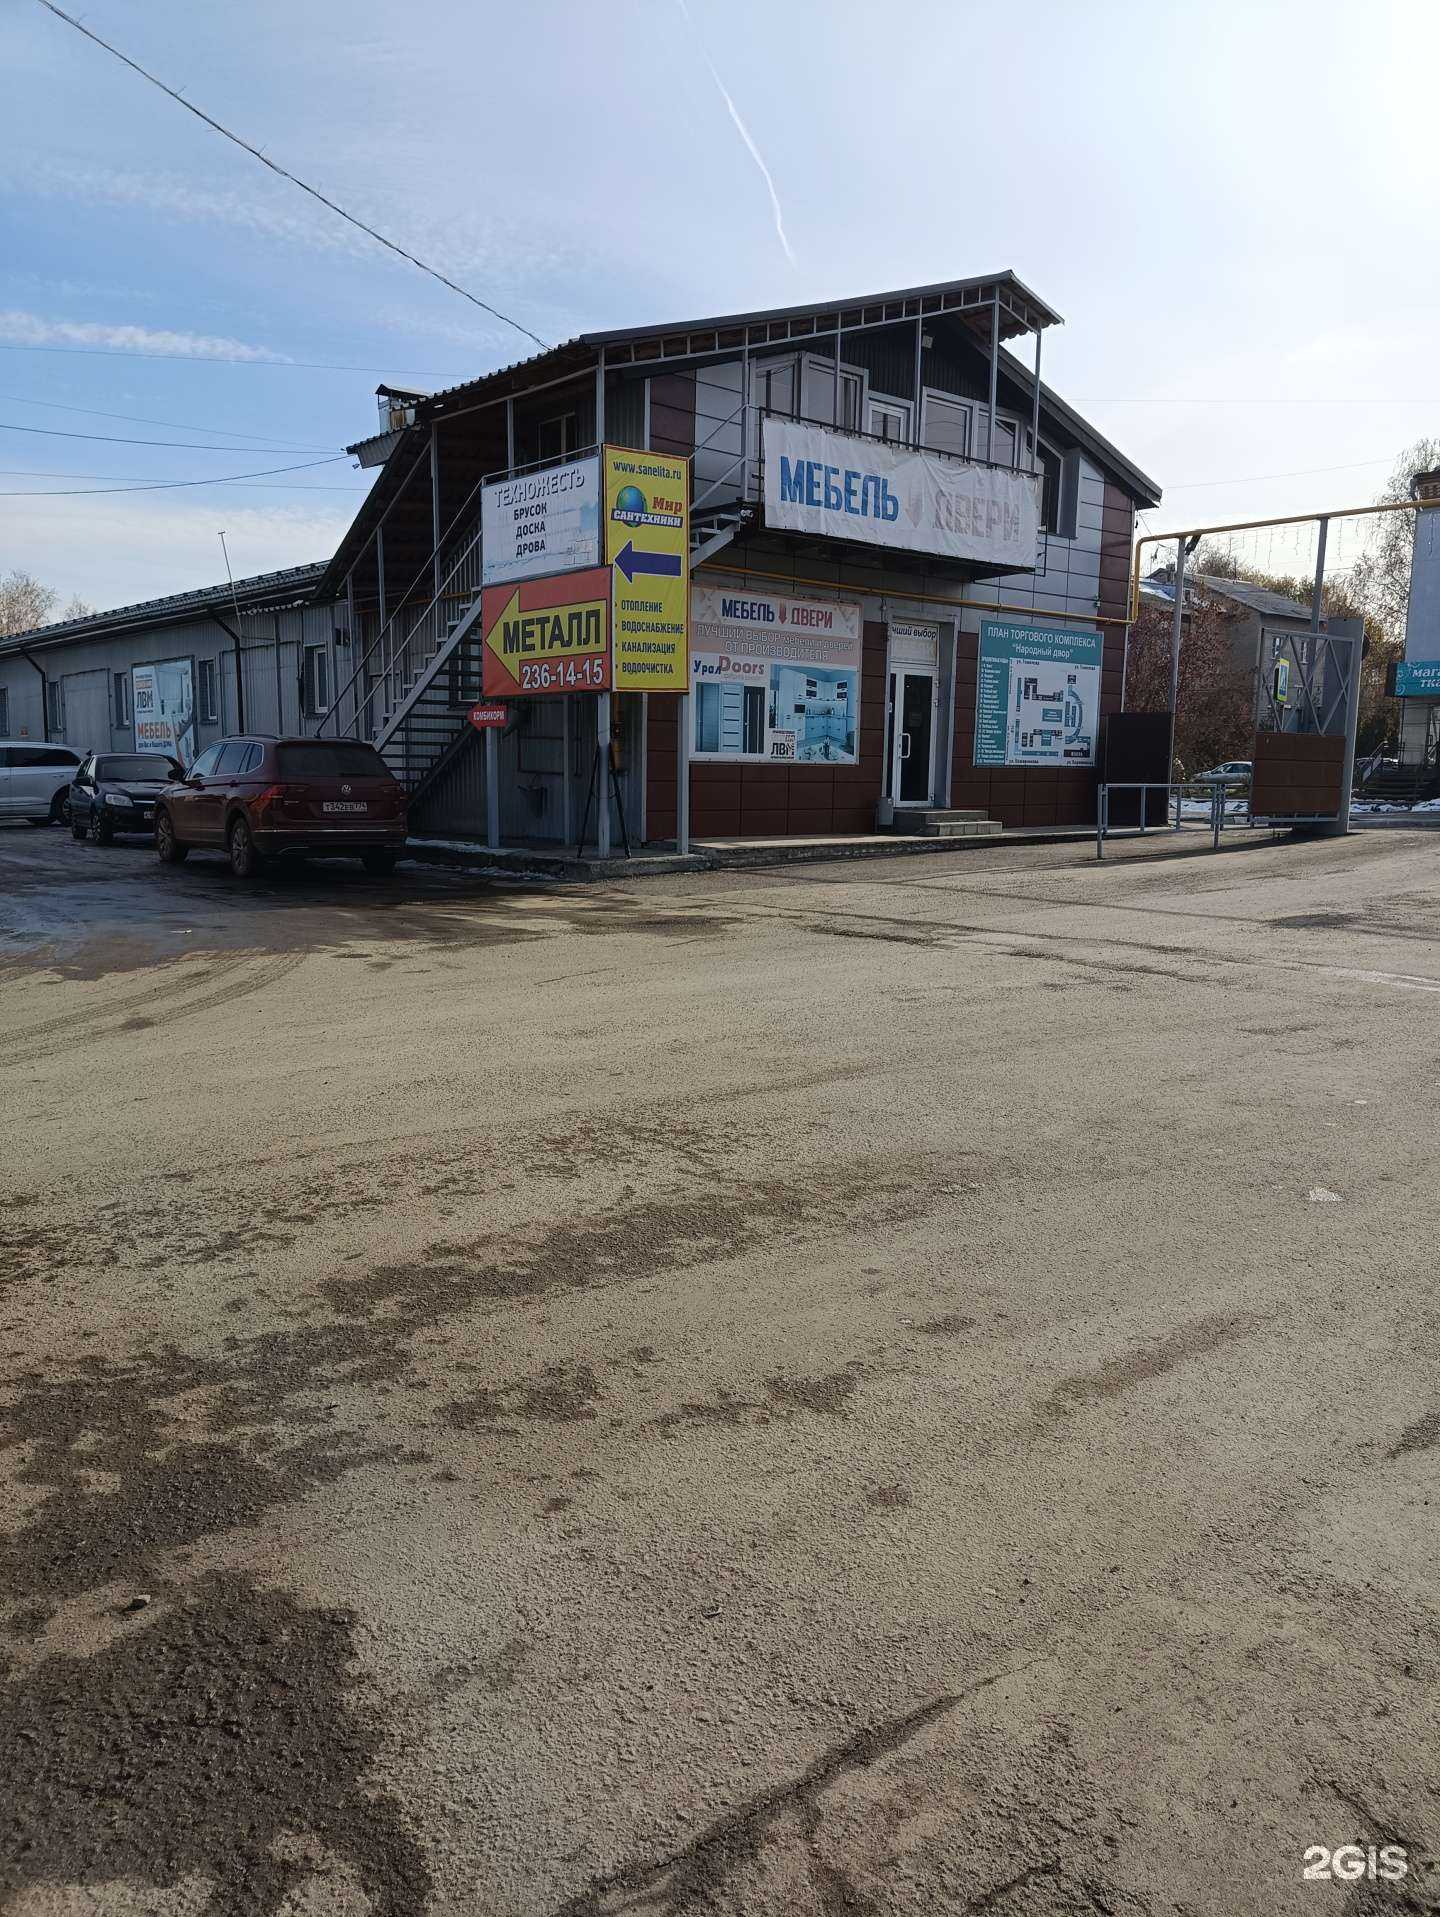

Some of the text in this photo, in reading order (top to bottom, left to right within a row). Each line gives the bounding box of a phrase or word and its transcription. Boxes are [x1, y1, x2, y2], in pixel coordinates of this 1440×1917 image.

[613, 461, 682, 480] www.sanelita.ru
[780, 456, 899, 521] МЕБЕЛЬ
[513, 502, 547, 521] БРУСОК
[652, 496, 683, 514] Мир
[613, 510, 681, 527] САНТЕХНИКИ
[516, 521, 546, 540] ДОСКА
[516, 539, 546, 558] ДРОВА
[621, 600, 663, 613] ОТОПЛЕНИЕ
[722, 598, 833, 629] МЕБЕЛЬ ДВЕРИ
[503, 608, 601, 654] МЕТАЛЛ
[621, 620, 684, 635] ВОДОСНАБЖЕНИЕ
[988, 626, 1096, 649] ПЛАН ТОРГОВОГО КОМПЛЕКСА
[621, 642, 676, 655] КАНАЛИЗАЦИЯ
[522, 658, 603, 689] 236-14-15
[622, 662, 674, 675] ВОДООЧИСТКА
[138, 720, 171, 740] МЕБЕЛЬ
